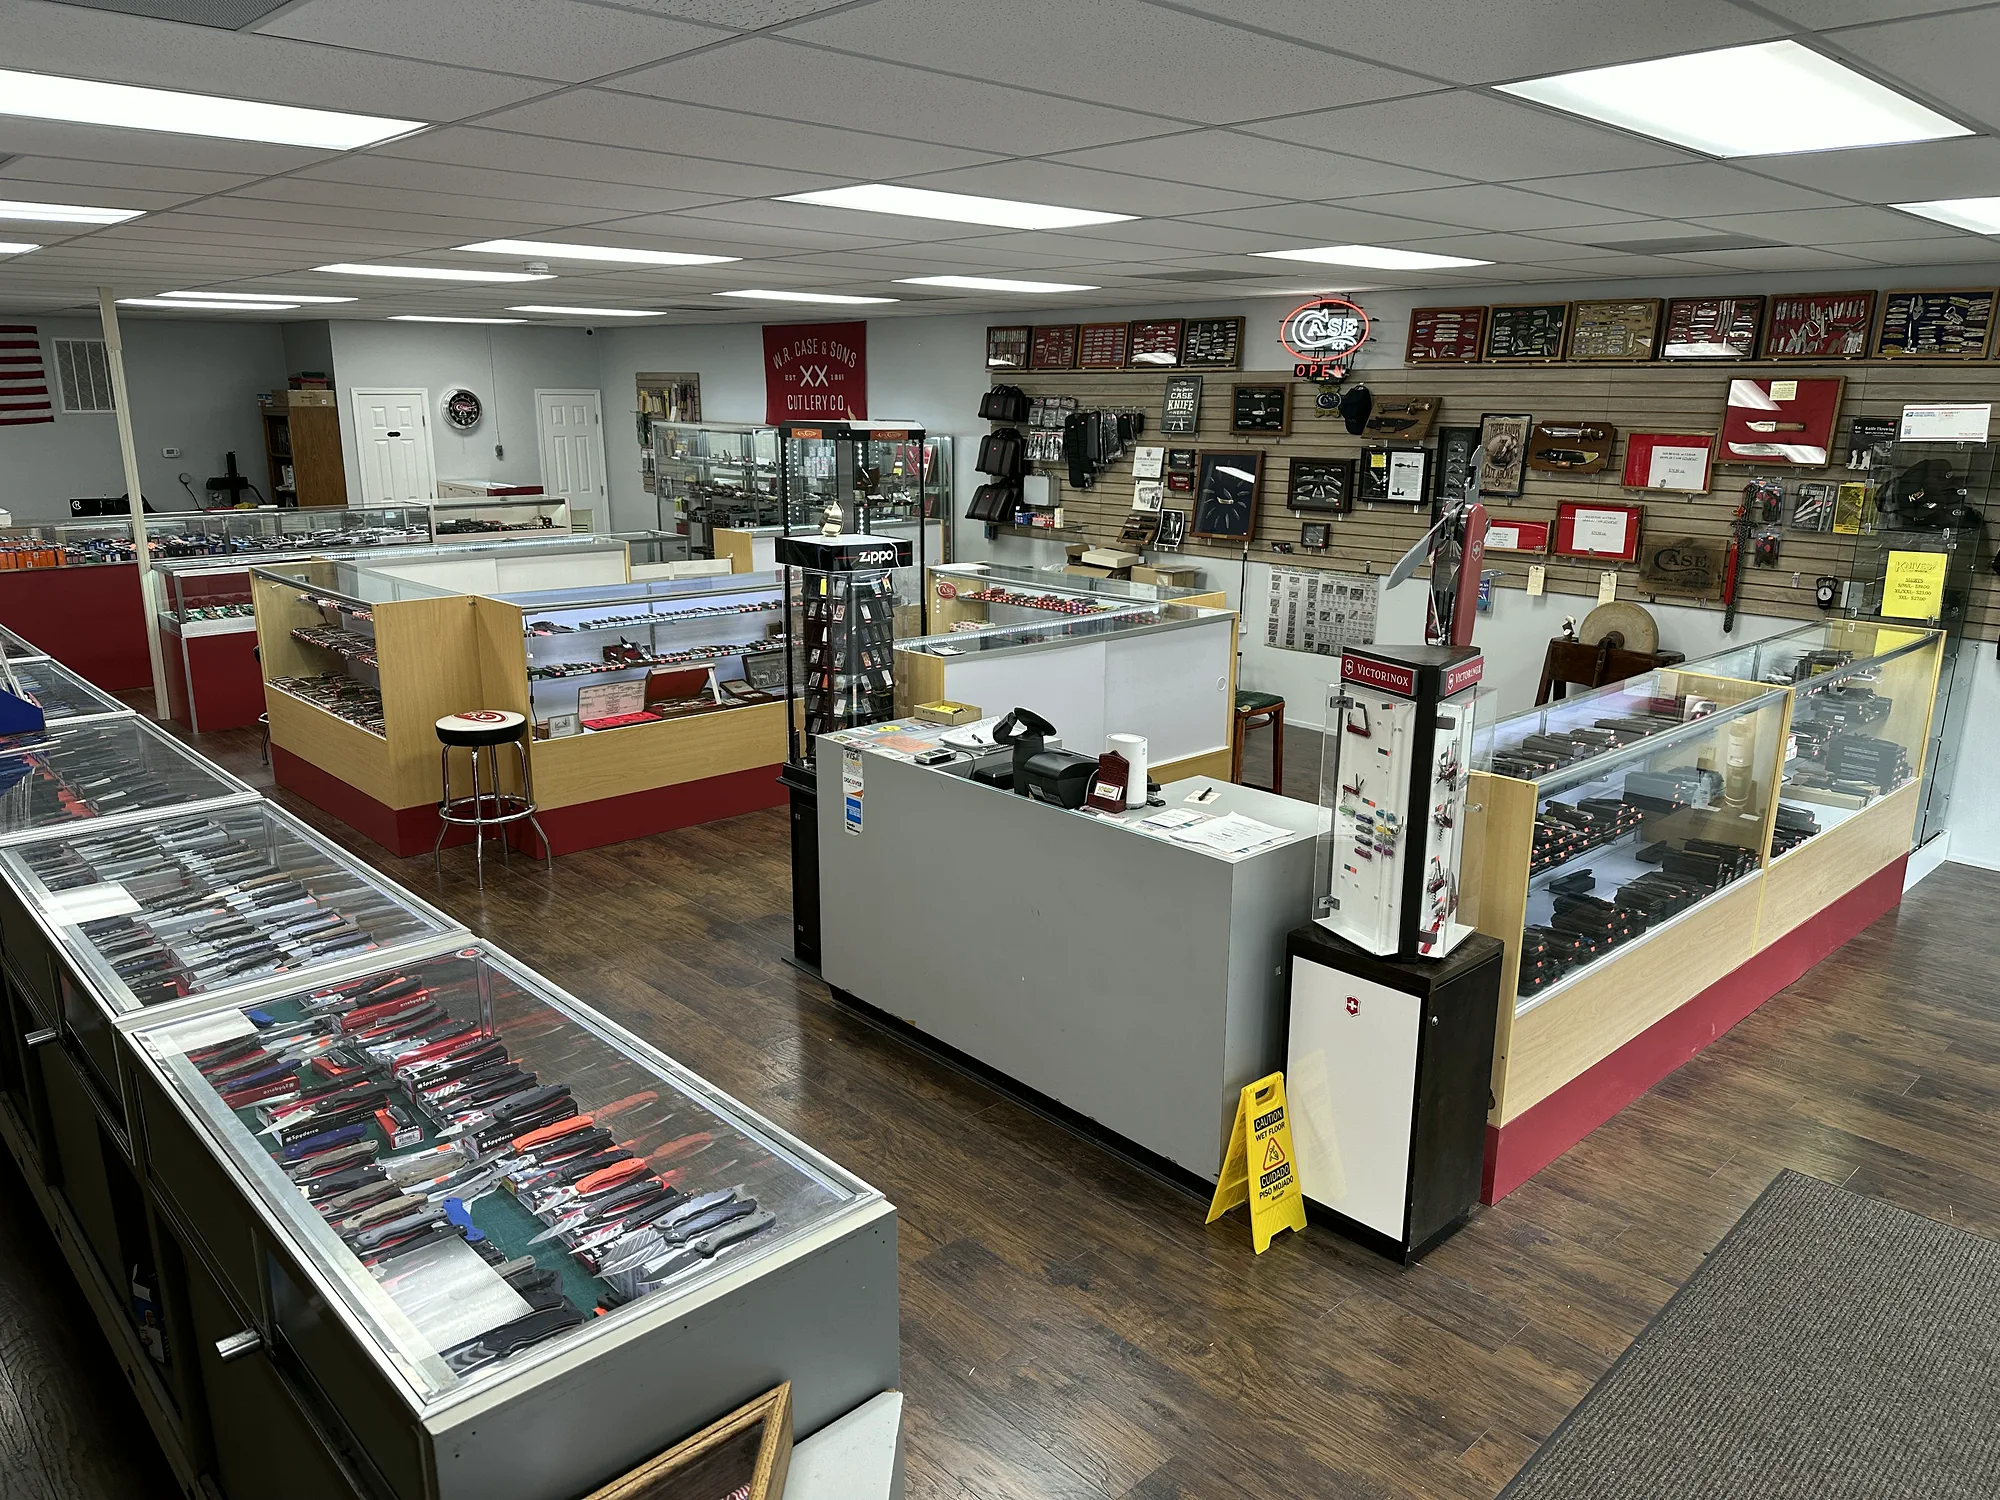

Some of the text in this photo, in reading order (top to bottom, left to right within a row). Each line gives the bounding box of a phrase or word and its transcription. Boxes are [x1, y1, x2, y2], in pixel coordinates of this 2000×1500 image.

[1292, 308, 1358, 348] CASE
[773, 338, 857, 370] W.R. CASE & SONS
[1331, 341, 1346, 350] XX
[800, 364, 829, 388] XX
[1296, 364, 1346, 378] OPEN
[787, 394, 847, 412] CUTLERY CO.
[1167, 399, 1195, 412] KNIFE
[1170, 392, 1194, 400] CASE
[1653, 548, 1710, 576] CASE
[1357, 663, 1409, 687] VICTORINOX
[1455, 664, 1482, 683] VICTORINOX
[422, 1075, 447, 1087] Spyderco
[1255, 1108, 1283, 1131] CAUTION
[291, 1127, 319, 1140] Spyderco
[487, 1132, 514, 1146] Spyderco
[1255, 1121, 1285, 1142] WET FLOOR
[1261, 1163, 1290, 1188] CUIDADO
[1259, 1187, 1273, 1200] PISO
[1272, 1175, 1294, 1194] MOJADO
